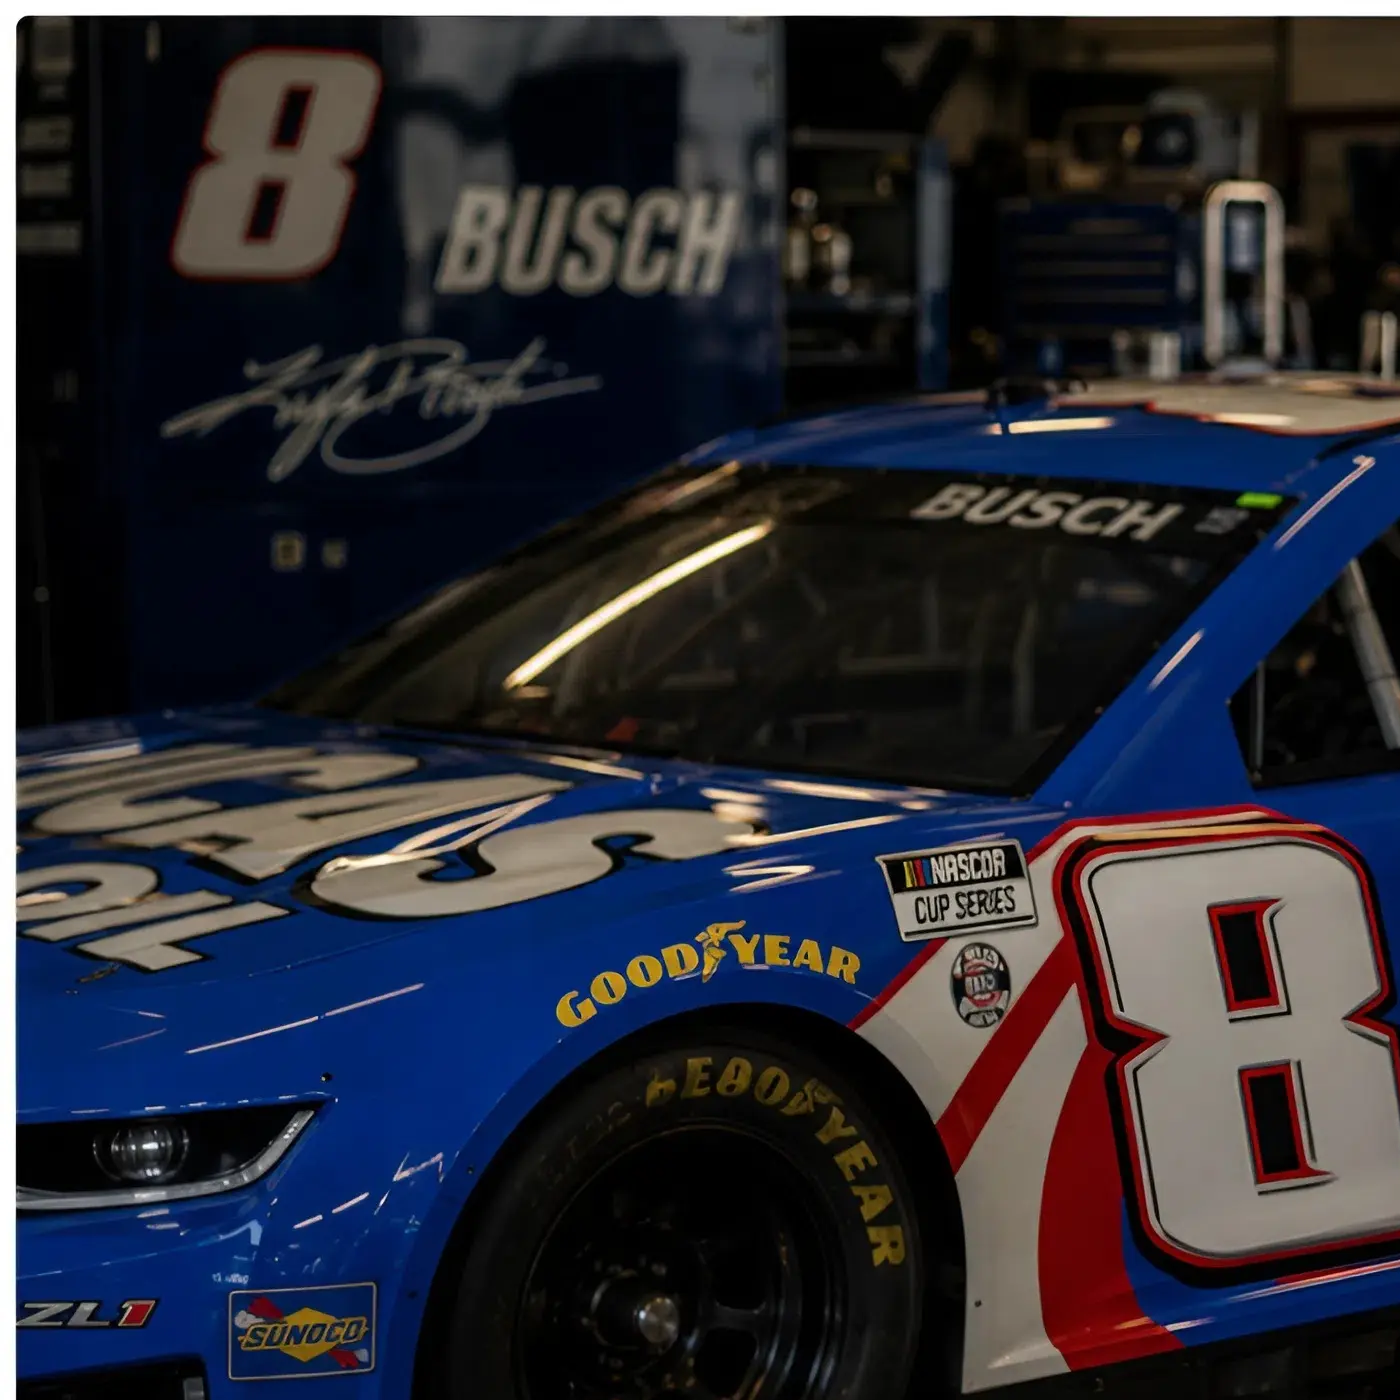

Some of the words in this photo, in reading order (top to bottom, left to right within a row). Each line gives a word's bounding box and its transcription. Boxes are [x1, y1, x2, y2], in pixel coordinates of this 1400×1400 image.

[170, 46, 383, 281] 8
[435, 184, 742, 295] BUSCH
[910, 483, 1175, 541] BUSCH
[914, 893, 951, 925] CUP
[555, 926, 861, 1028] GOODYEAR
[16, 1299, 158, 1328] ZL1
[241, 1316, 370, 1351] SUNOCO
